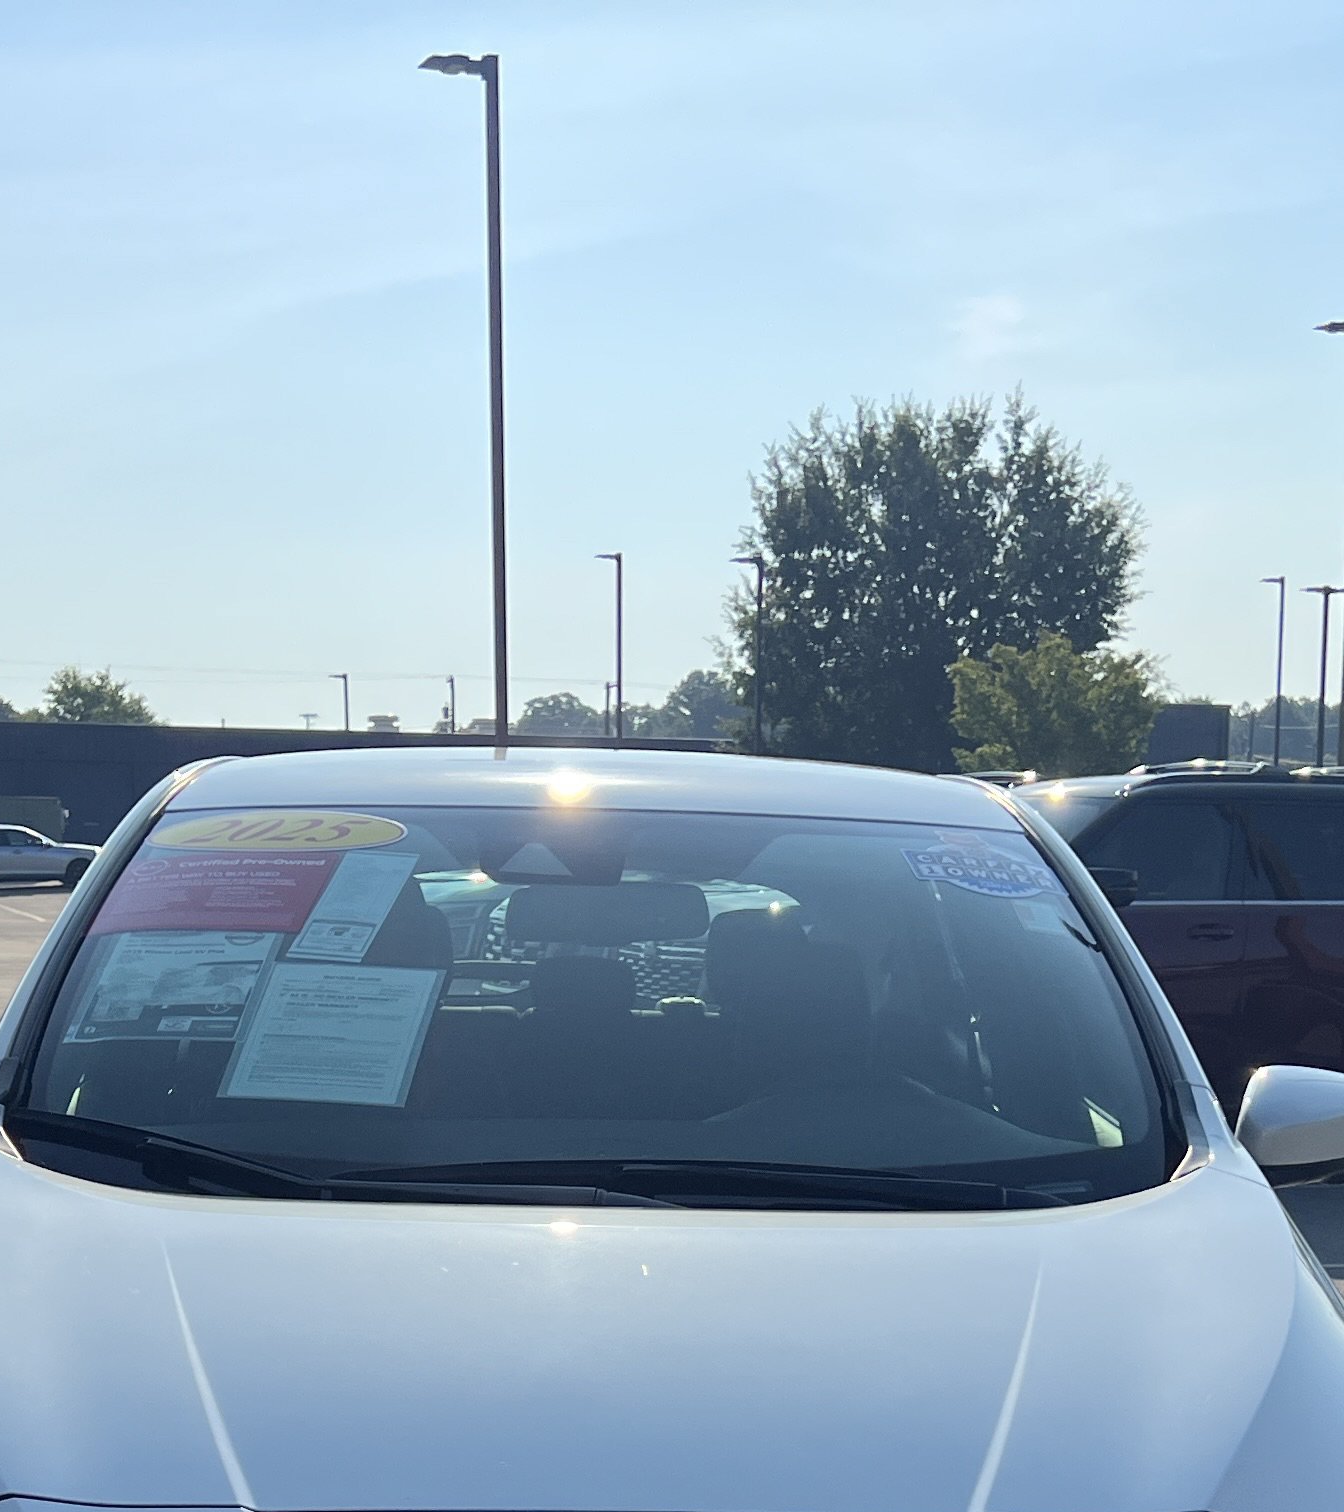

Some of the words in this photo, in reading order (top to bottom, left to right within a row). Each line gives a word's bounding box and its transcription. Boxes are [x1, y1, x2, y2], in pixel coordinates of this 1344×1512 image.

[182, 818, 372, 843] 2025
[178, 858, 240, 868] Certified
[242, 857, 327, 867] Pre-Owned
[916, 854, 1052, 878] CARFAX
[946, 867, 1054, 888] OWNER
